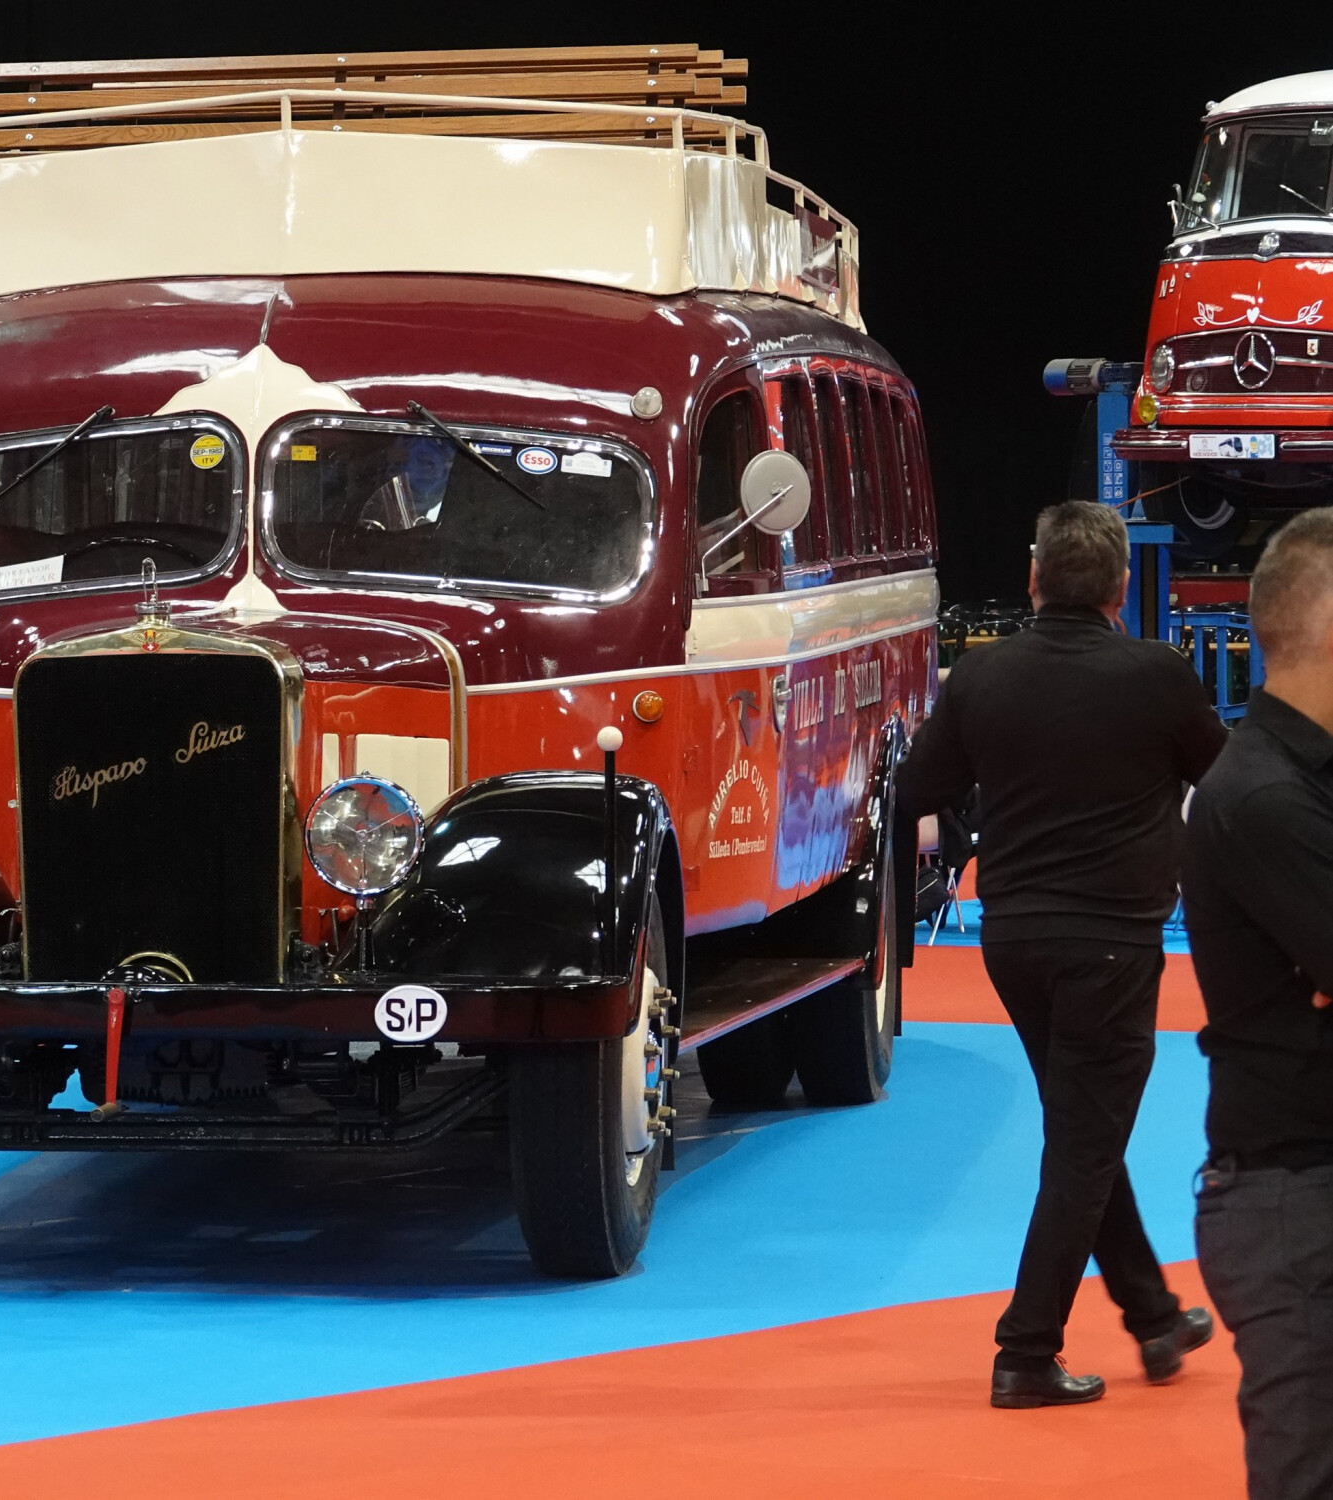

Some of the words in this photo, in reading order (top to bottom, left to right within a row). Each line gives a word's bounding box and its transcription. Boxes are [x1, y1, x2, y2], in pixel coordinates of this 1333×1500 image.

[19, 563, 50, 576] FAVOR
[794, 676, 824, 731] VILLA
[54, 757, 148, 809] Hispano
[175, 721, 246, 763] Suiza
[709, 759, 749, 830] AURELIO
[709, 839, 730, 858] Silleda
